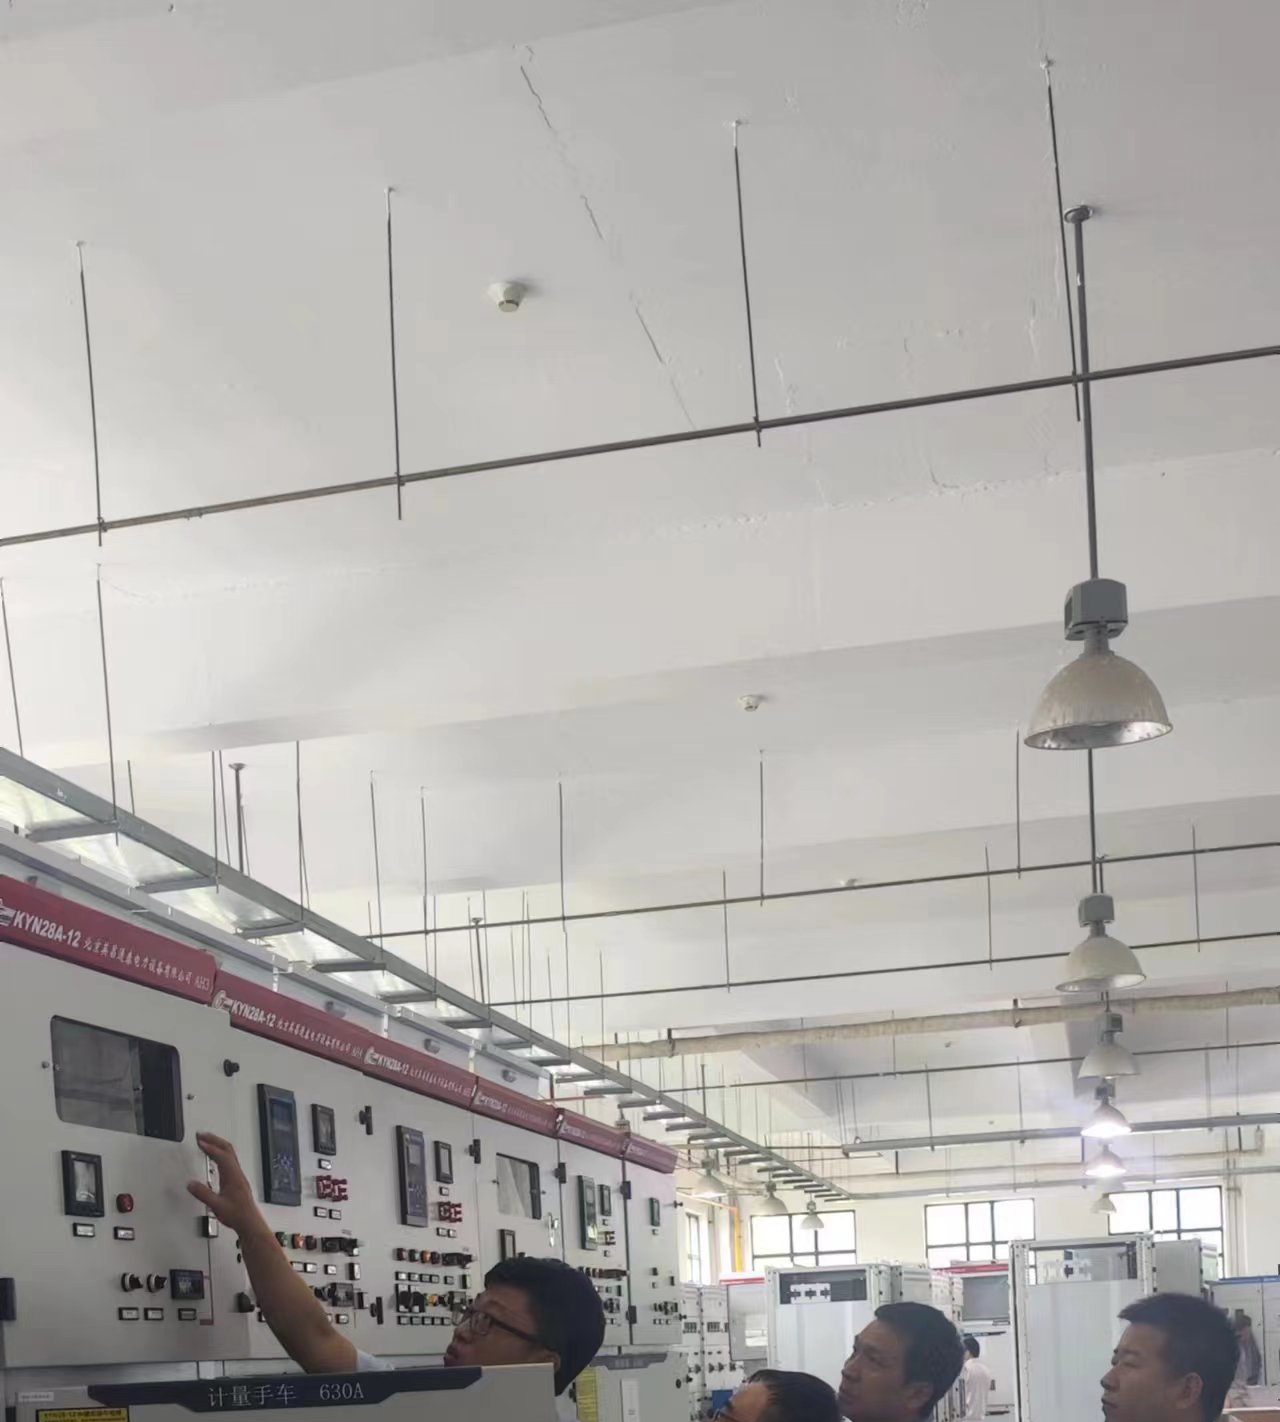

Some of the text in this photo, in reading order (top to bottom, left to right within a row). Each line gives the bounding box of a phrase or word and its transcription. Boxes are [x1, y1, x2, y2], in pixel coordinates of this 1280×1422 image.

[13, 911, 81, 948] KYN28A-12
[232, 1000, 276, 1028] KYN28A-12
[208, 1382, 364, 1407] 计量手车 630A
